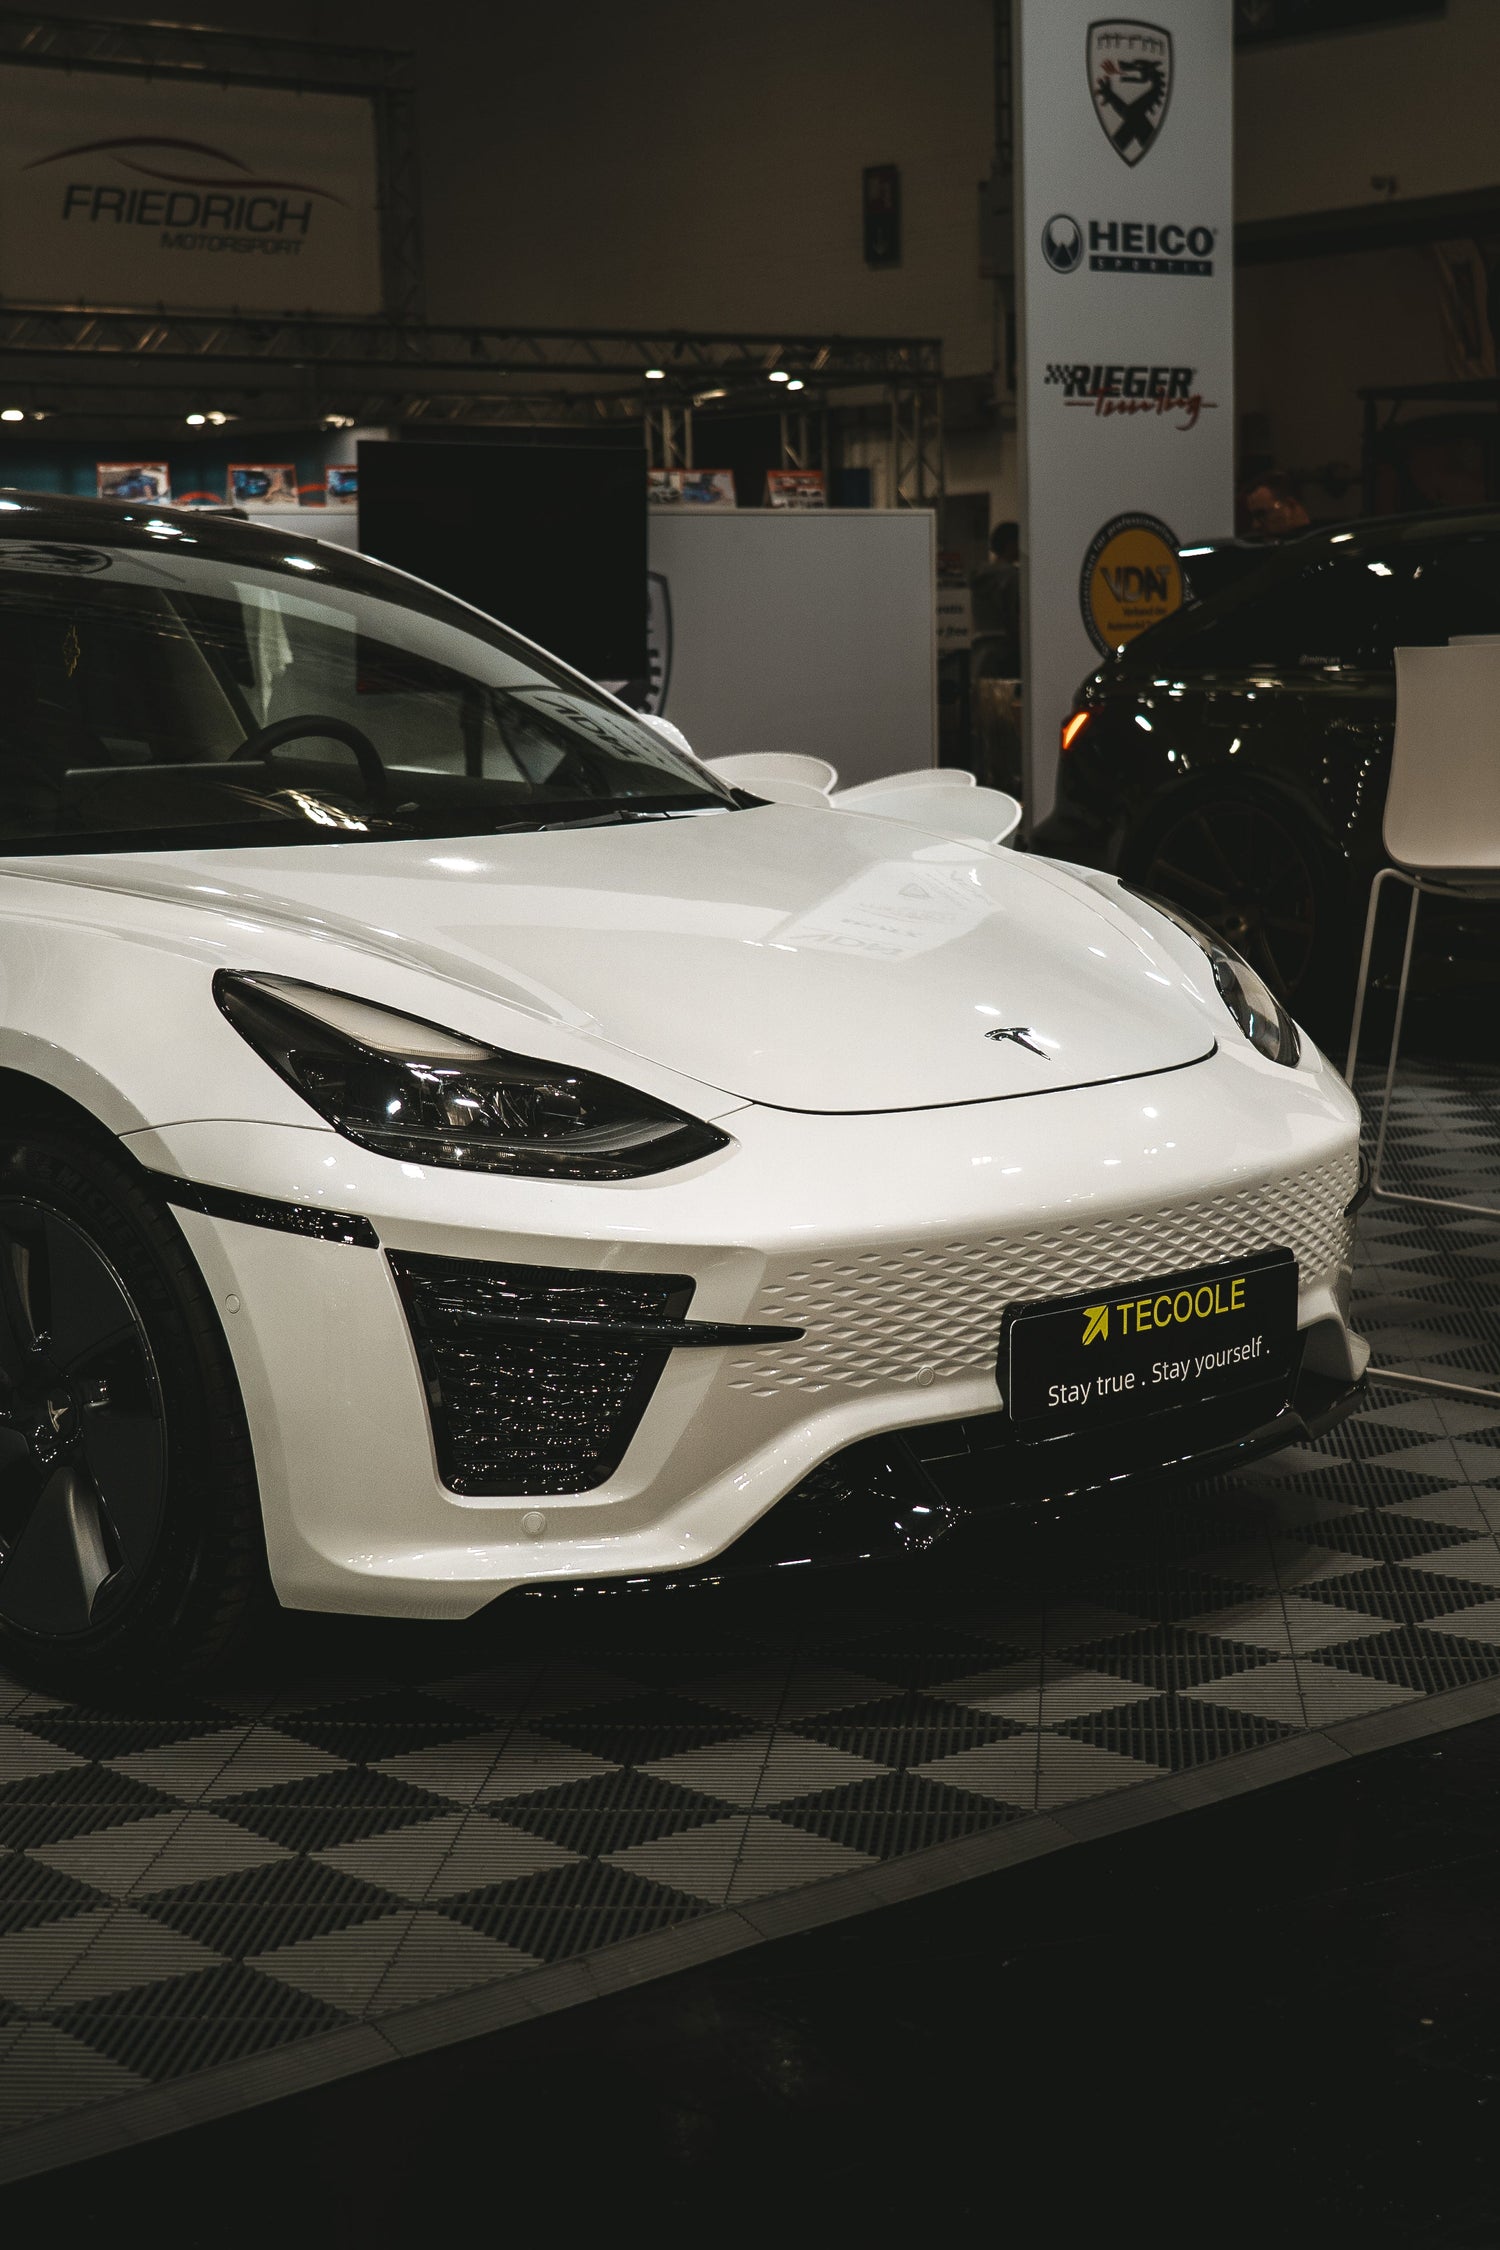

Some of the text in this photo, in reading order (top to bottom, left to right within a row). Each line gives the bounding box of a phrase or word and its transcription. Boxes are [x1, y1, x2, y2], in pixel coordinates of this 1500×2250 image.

[62, 184, 313, 234] FRIEDRICH
[160, 231, 304, 255] MOTORSPORT
[1088, 220, 1213, 257] HEICO
[1064, 363, 1193, 398] RIEGER
[1116, 1278, 1246, 1335] TECOOLE
[1048, 1380, 1092, 1407] Stay
[1096, 1369, 1136, 1396] true
[1152, 1358, 1190, 1386] Stay
[1195, 1336, 1263, 1376] yourself
